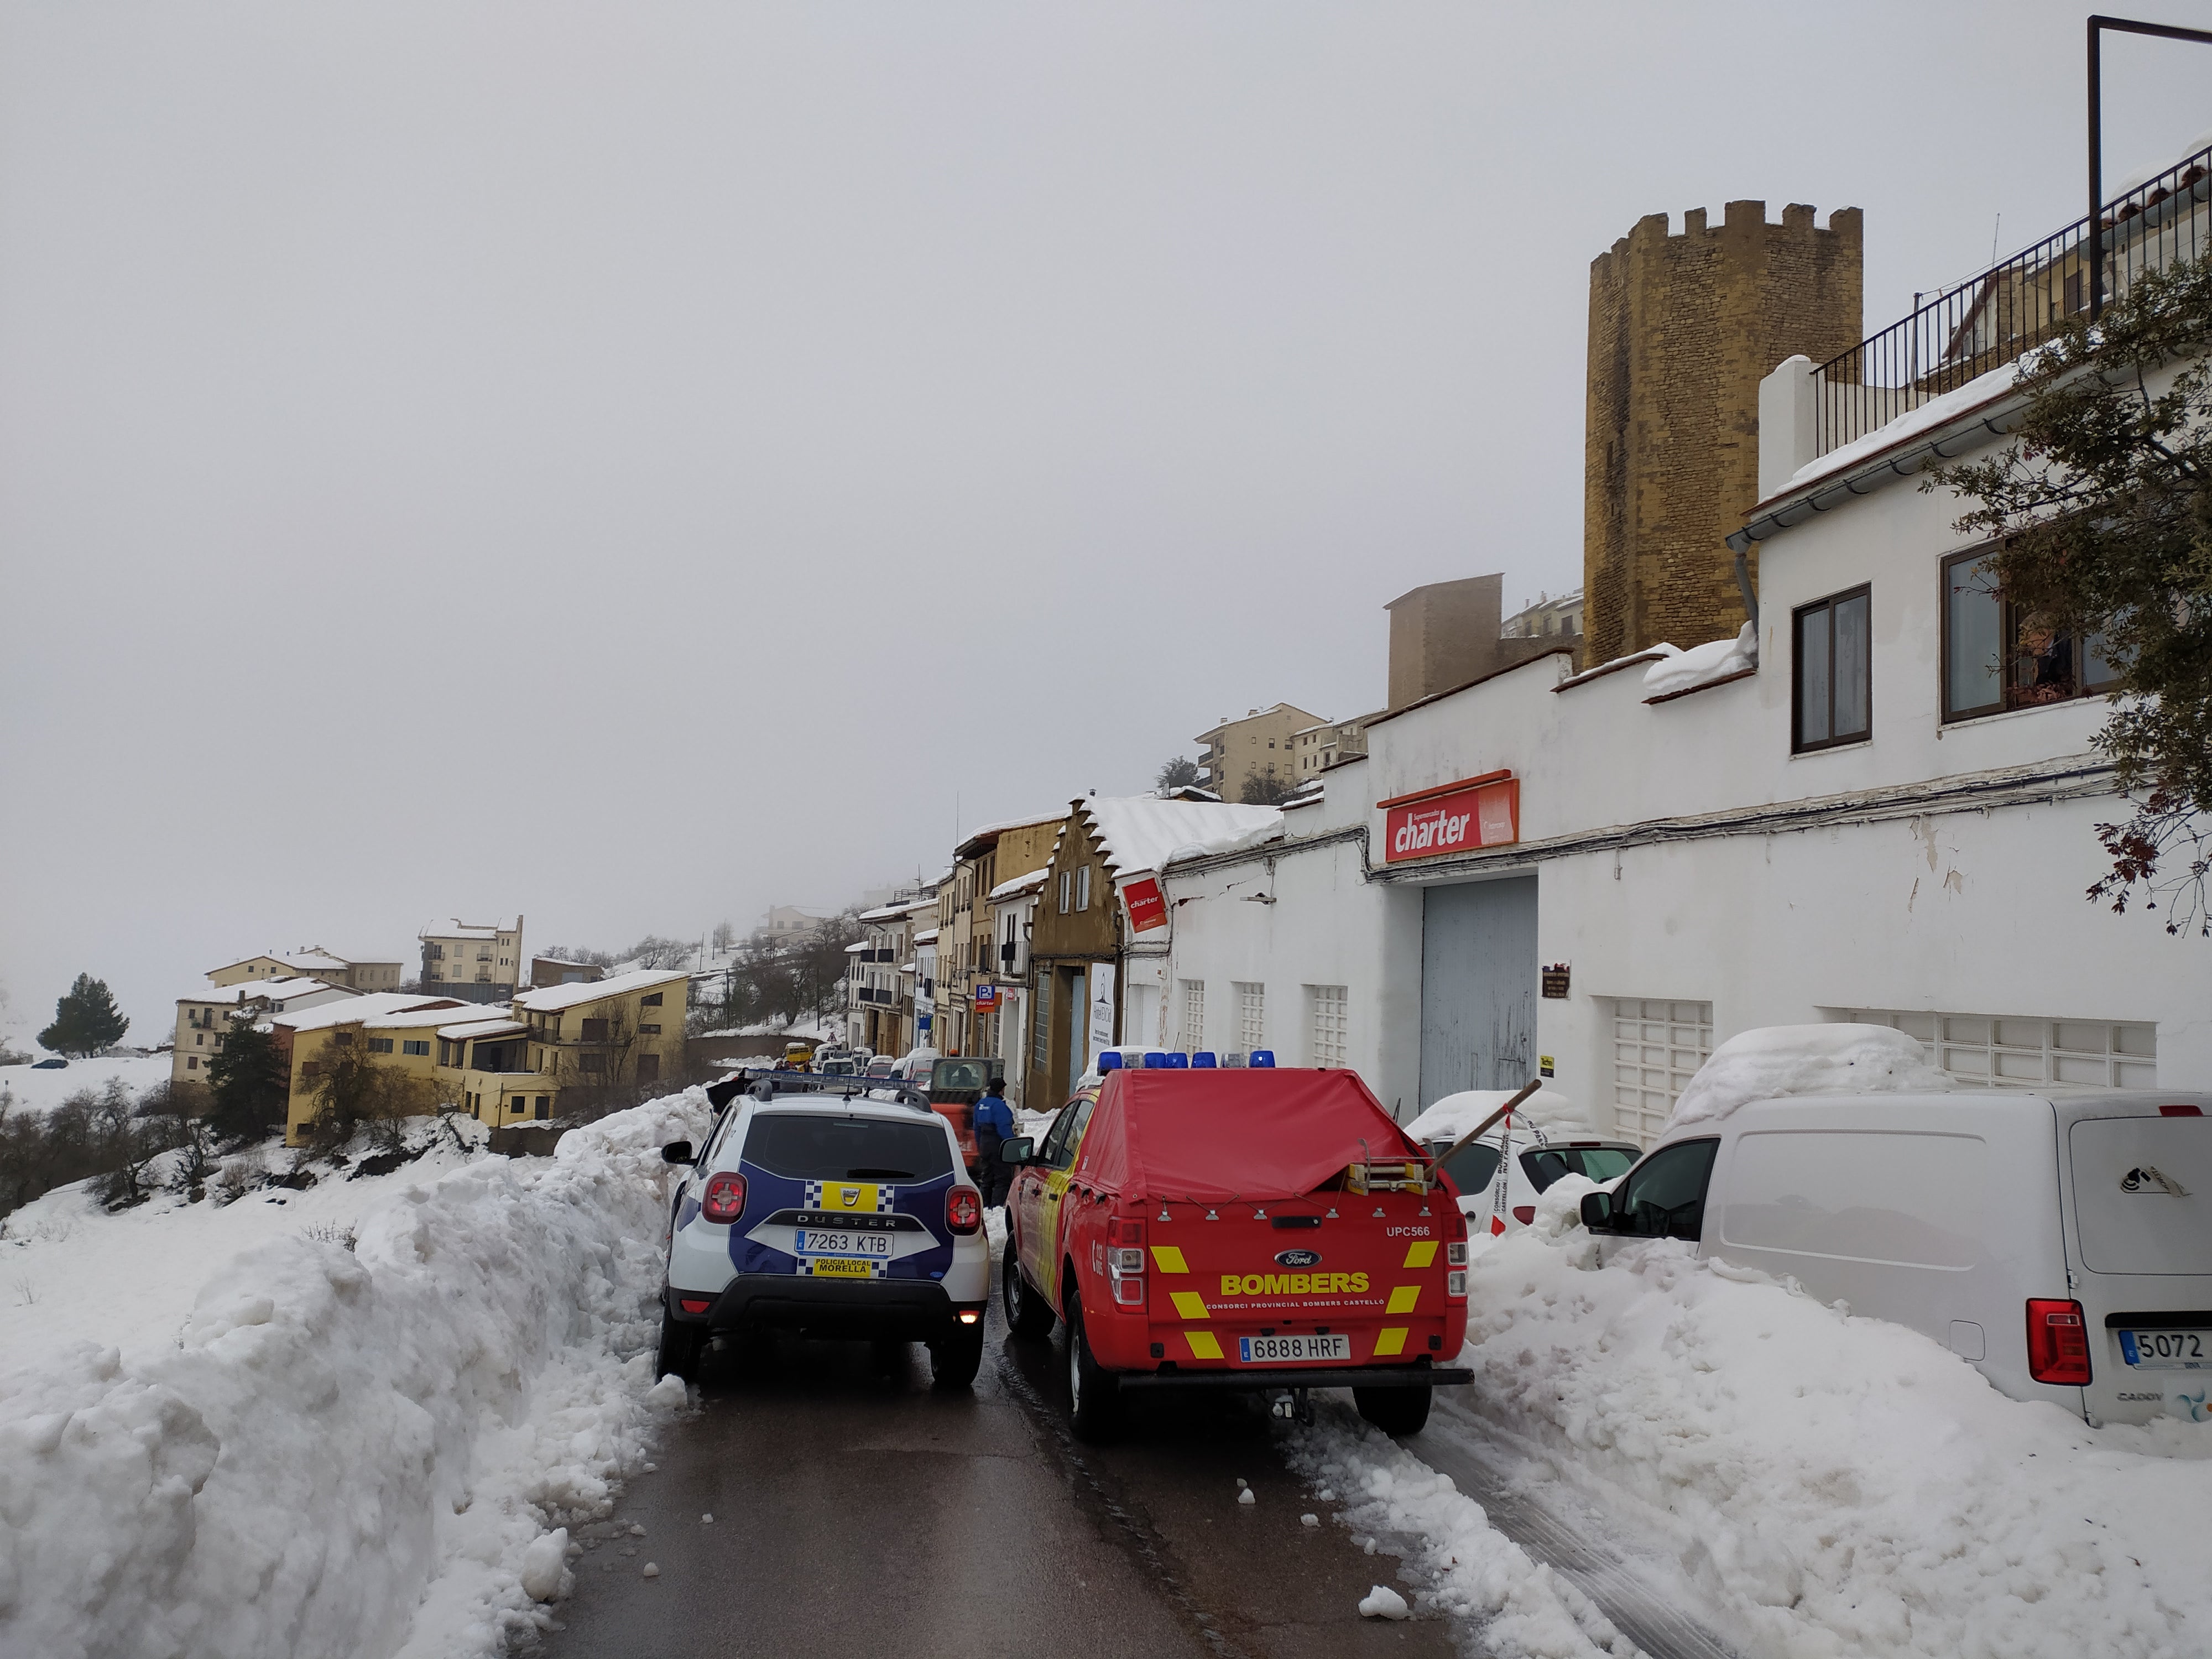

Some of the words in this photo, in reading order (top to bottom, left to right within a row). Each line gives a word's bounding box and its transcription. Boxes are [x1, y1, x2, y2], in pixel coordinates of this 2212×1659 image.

[1395, 810, 1470, 853] charter
[1130, 896, 1159, 909] charter
[980, 987, 988, 998] P
[1093, 1005, 1102, 1020] Hotel
[1102, 1006, 1105, 1021] El
[797, 1215, 895, 1227] DUSTER
[1387, 1227, 1430, 1237] UPC566
[808, 1233, 848, 1250] 7263
[857, 1236, 886, 1252] KTB
[1286, 1253, 1312, 1265] Ford
[1221, 1272, 1369, 1295] BOMBERS
[1254, 1339, 1302, 1358] 6888
[1308, 1338, 1343, 1357] HRF
[2138, 1334, 2203, 1358] 5072
